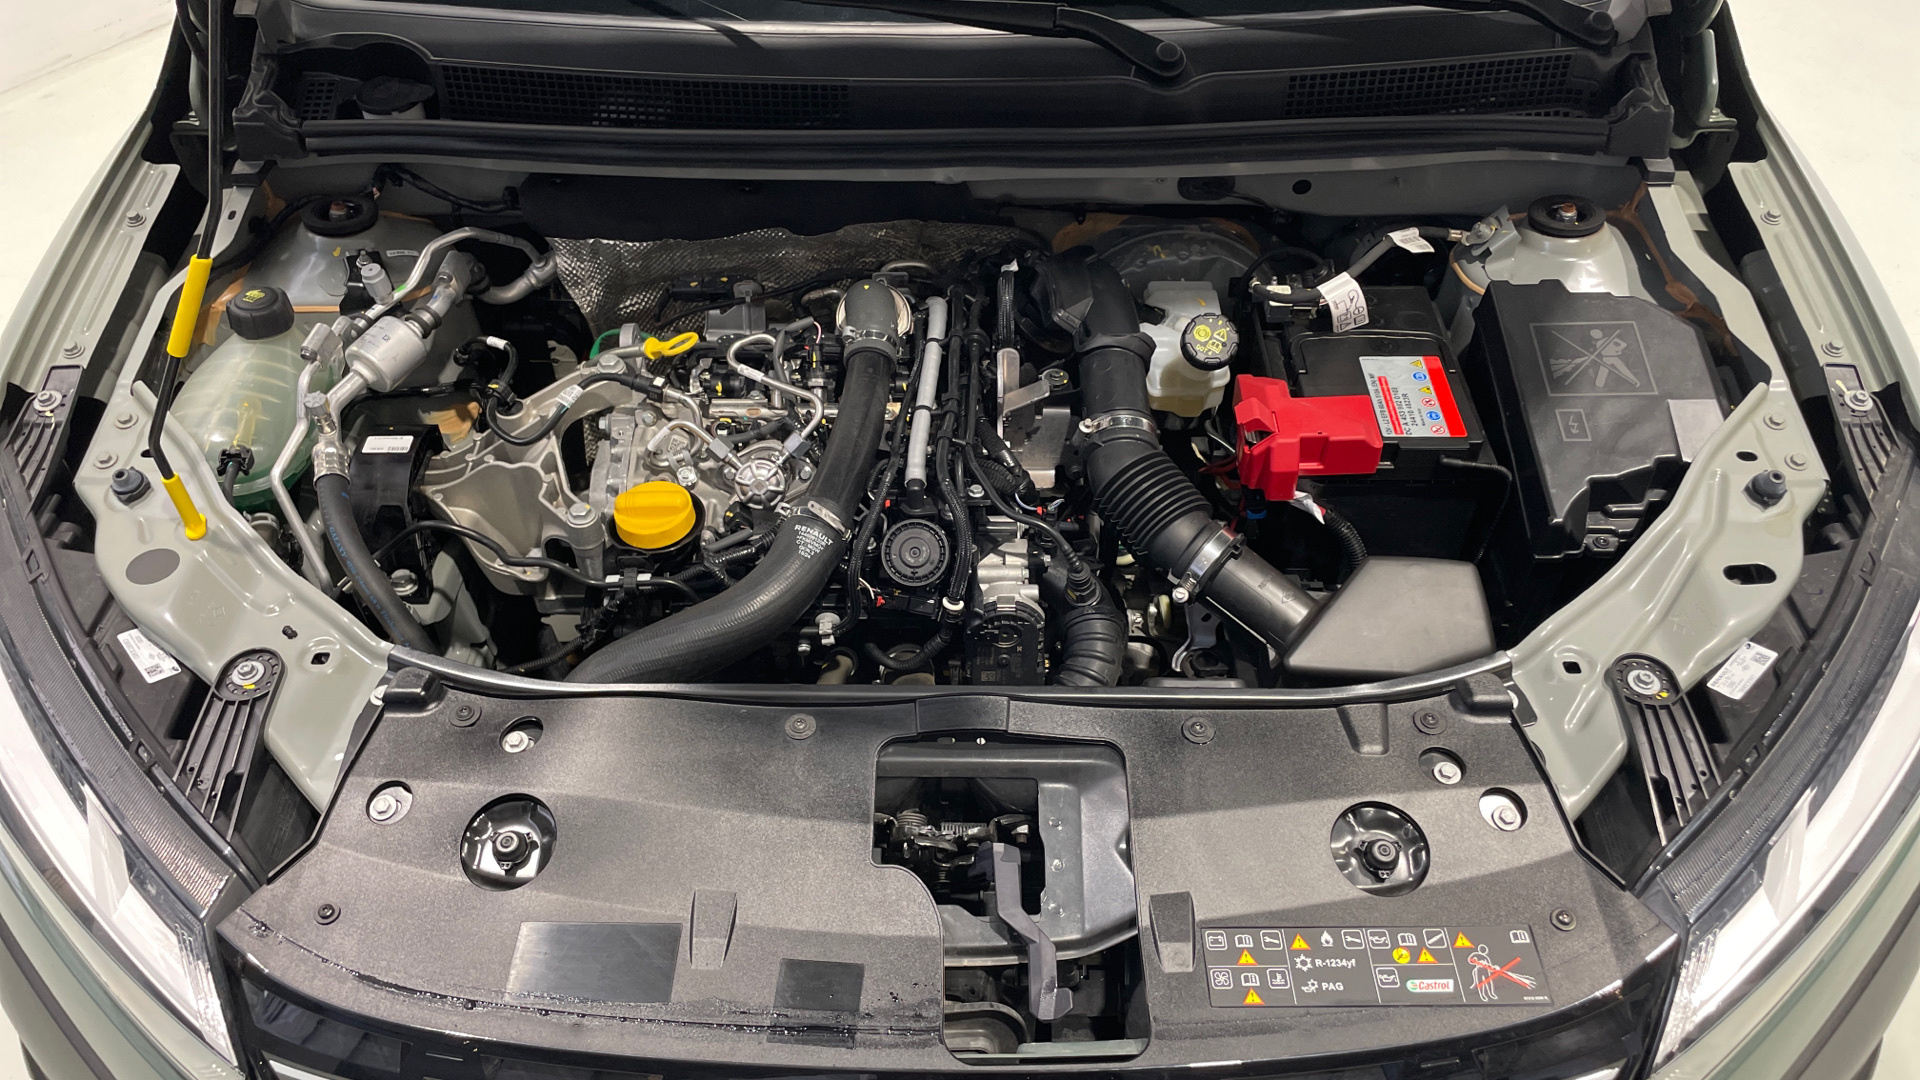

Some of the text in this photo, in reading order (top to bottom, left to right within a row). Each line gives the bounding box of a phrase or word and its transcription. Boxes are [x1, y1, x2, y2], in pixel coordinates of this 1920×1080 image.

[1196, 344, 1208, 353] DOT
[794, 524, 834, 546] RENAULT
[329, 527, 347, 557] GALAXY
[1315, 958, 1356, 969] R-1234yf
[1322, 982, 1344, 991] PAG
[1418, 981, 1450, 990] Castrol
